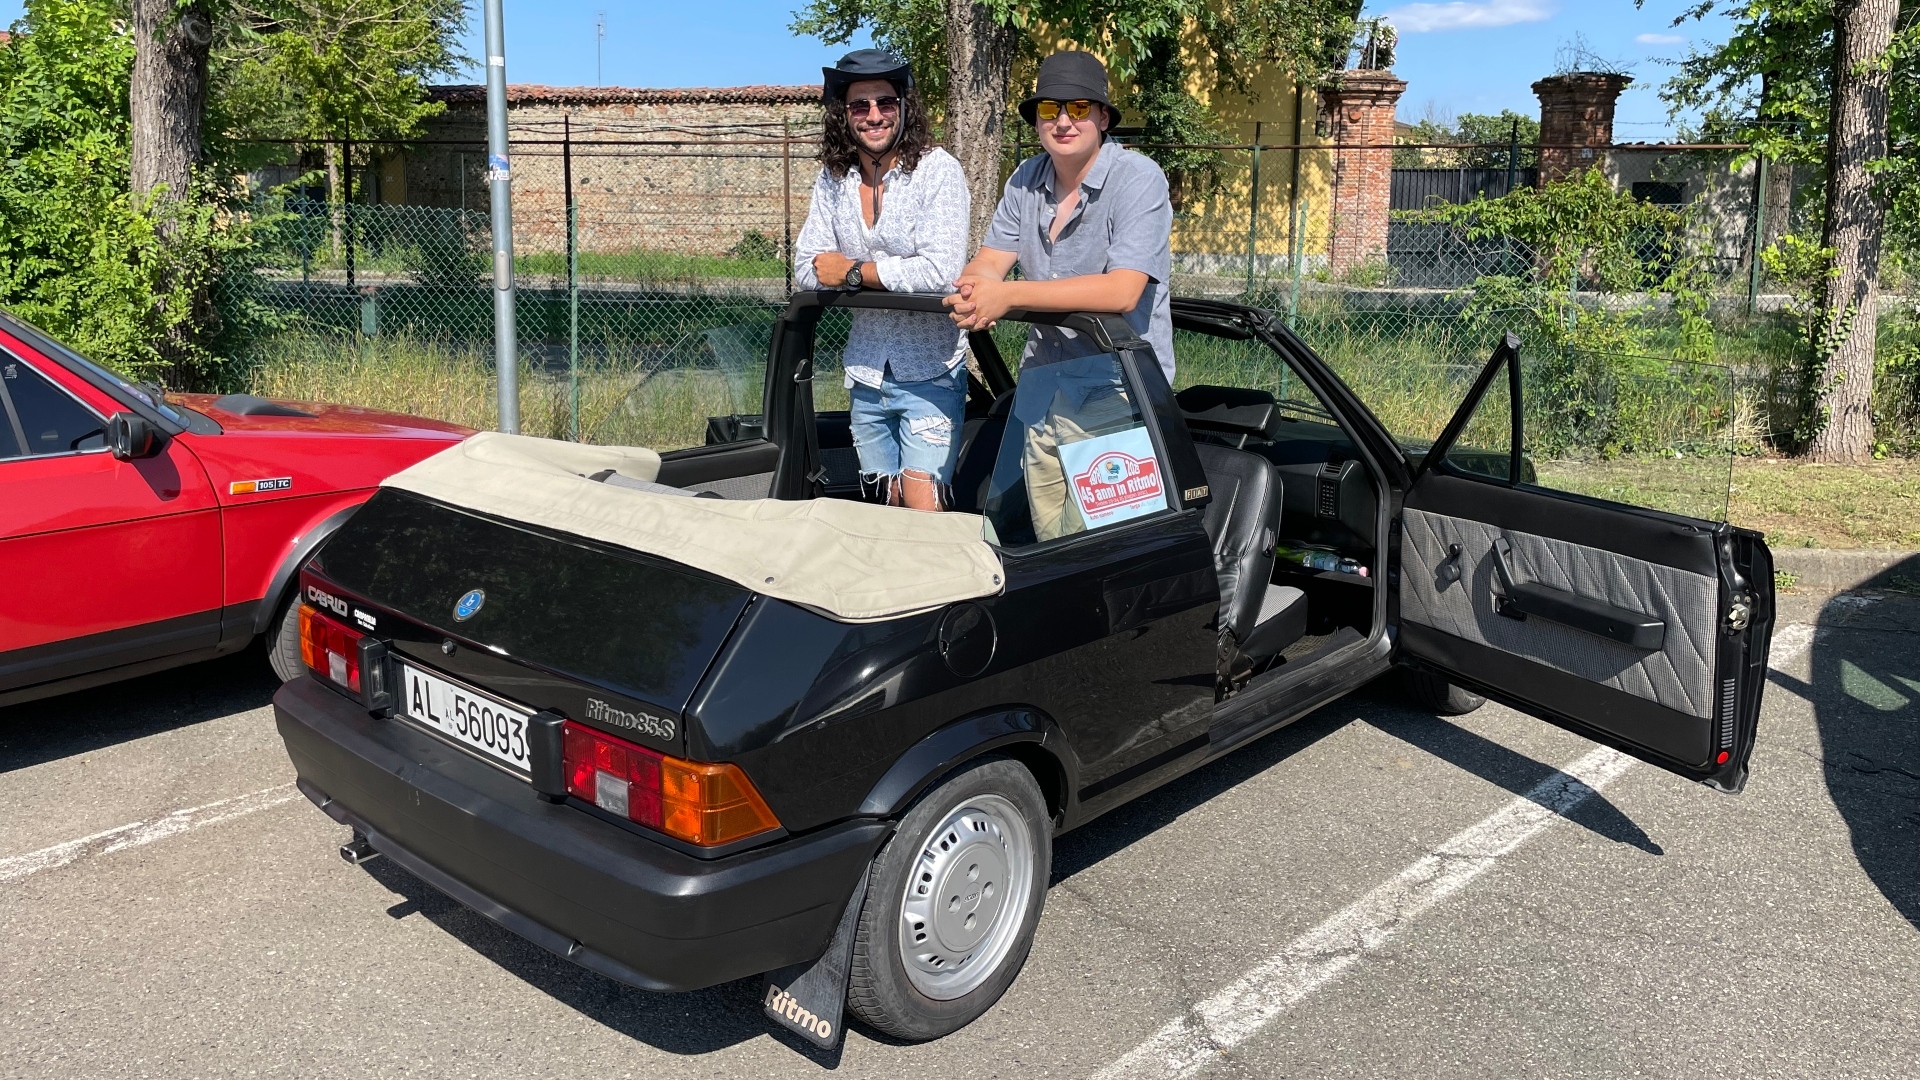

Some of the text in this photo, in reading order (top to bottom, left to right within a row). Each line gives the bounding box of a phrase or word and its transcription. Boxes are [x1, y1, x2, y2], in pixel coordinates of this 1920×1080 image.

[259, 479, 289, 489] 105 TC
[1080, 472, 1156, 503] 45 anni in Ritmo
[1185, 486, 1208, 501] FIAT
[308, 585, 348, 617] CABRIO
[413, 675, 531, 764] AL 56093
[445, 708, 455, 721] AL
[585, 698, 634, 730] Ritmo
[765, 984, 832, 1038] Ritmo
